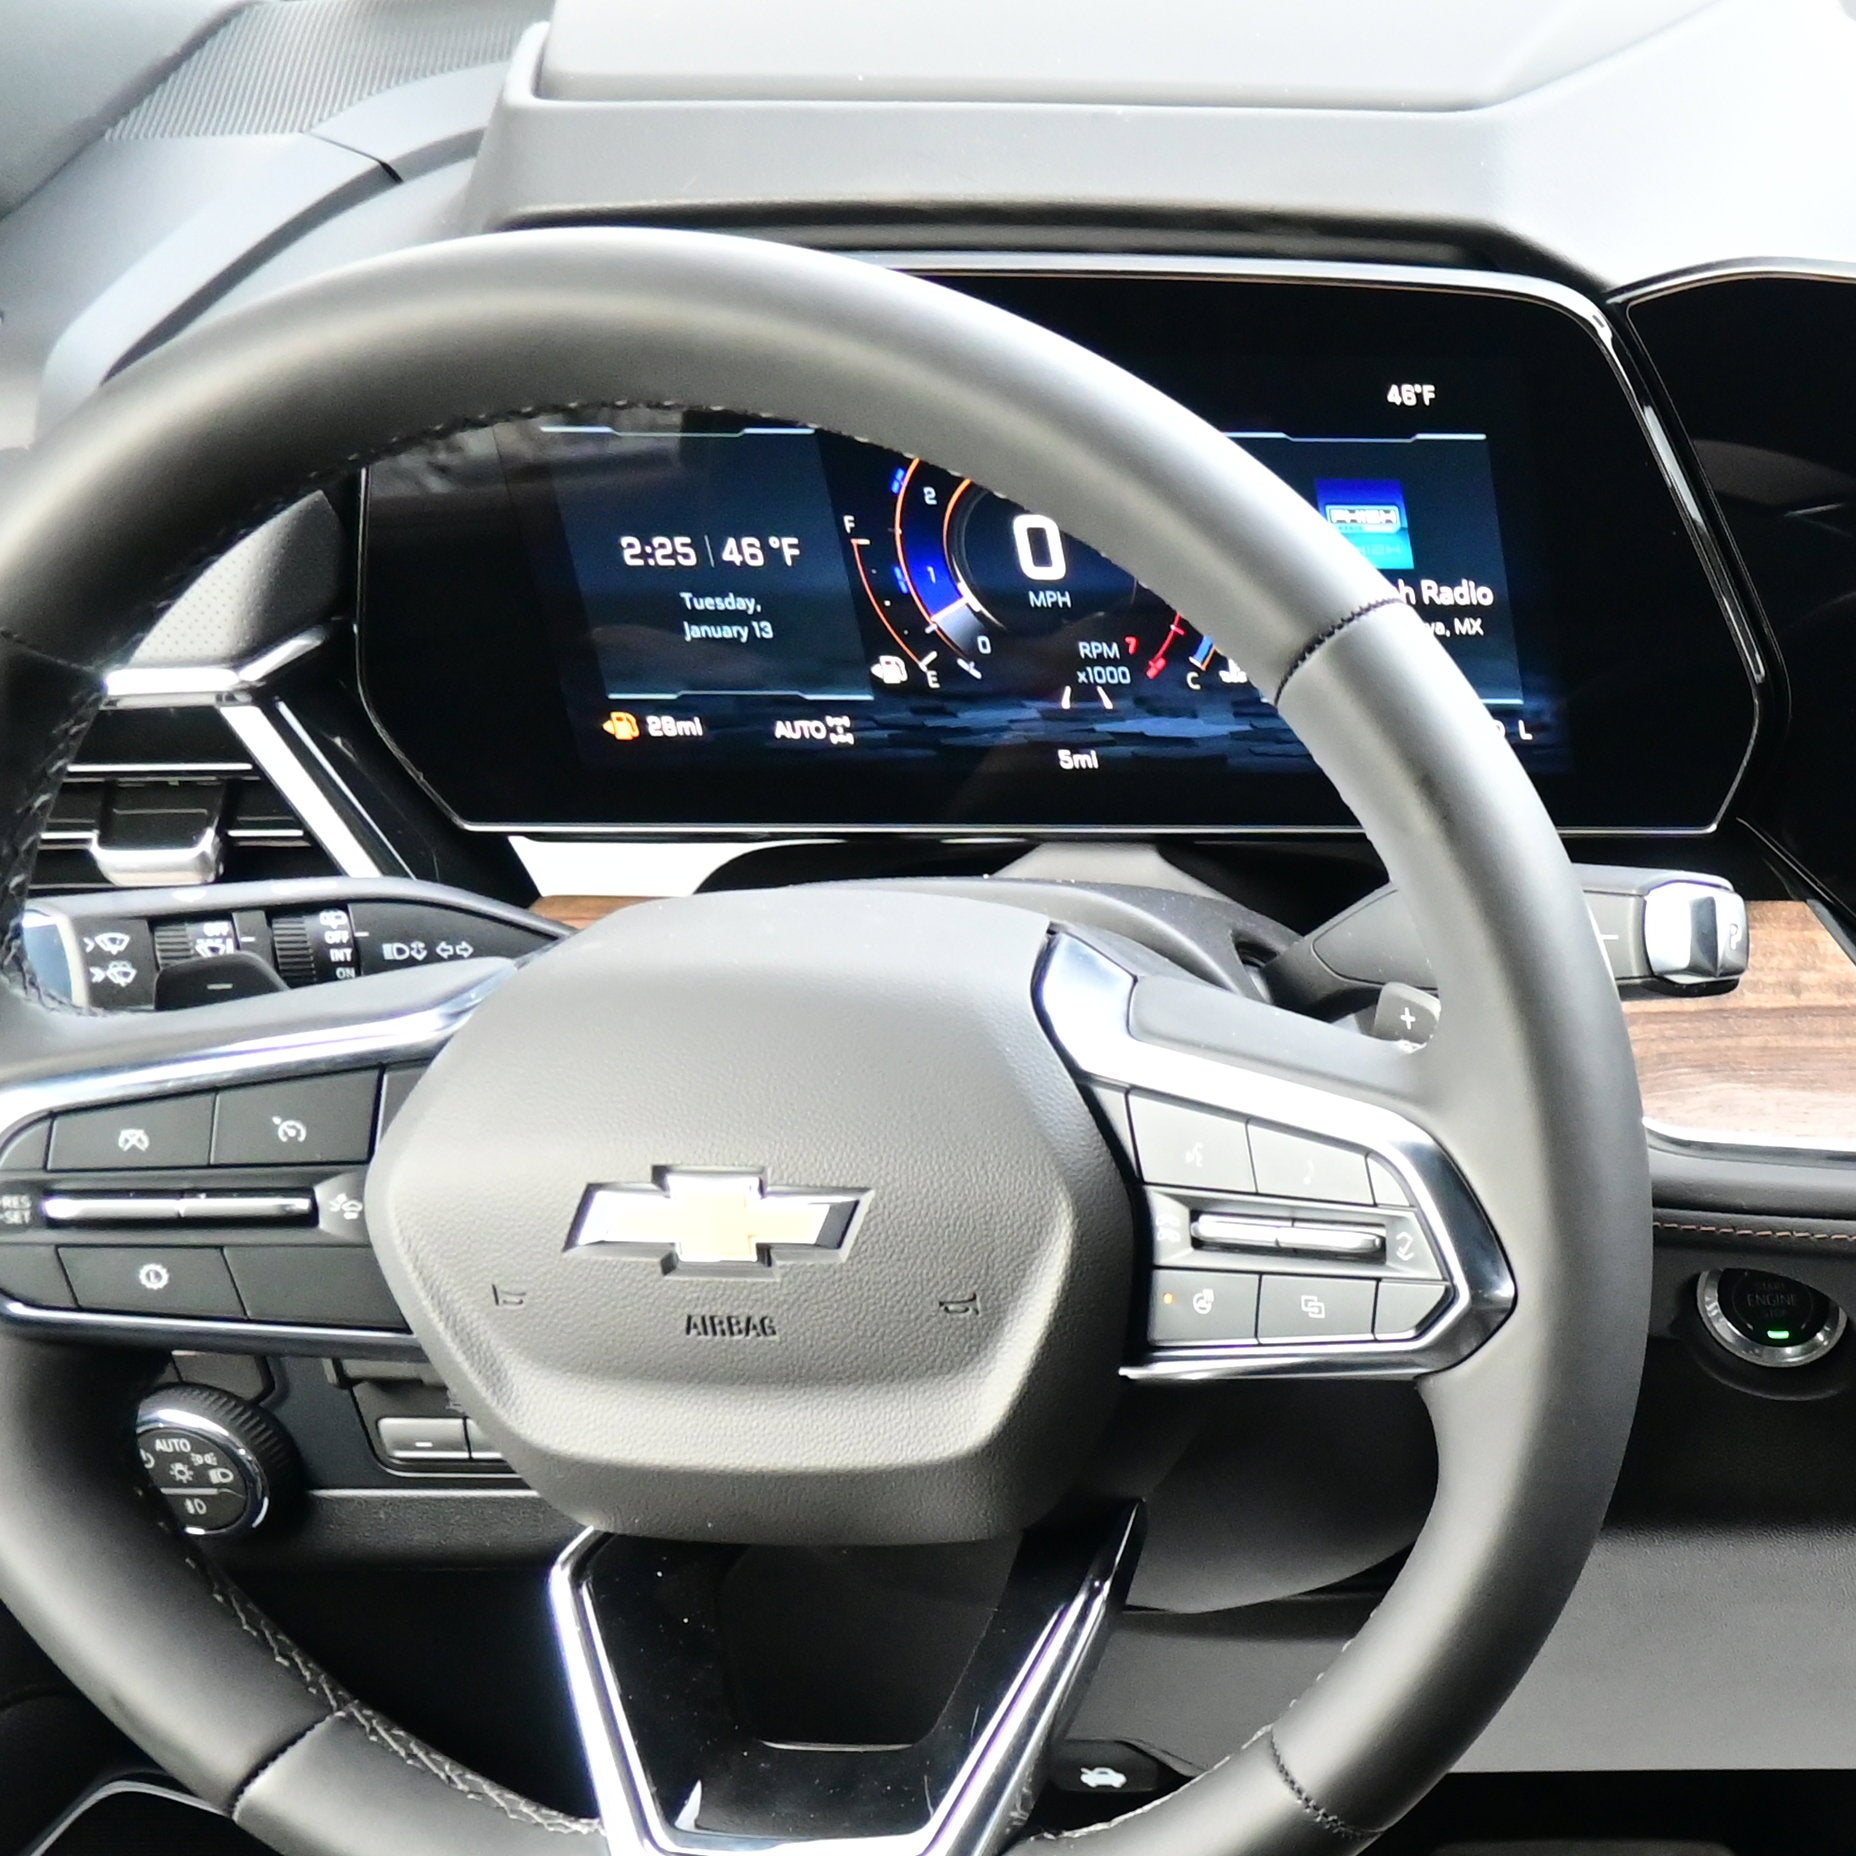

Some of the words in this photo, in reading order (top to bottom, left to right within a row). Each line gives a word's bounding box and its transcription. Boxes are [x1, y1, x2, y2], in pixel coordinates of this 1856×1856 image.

[1387, 384, 1435, 406] 46°F
[923, 487, 937, 505] 2
[843, 515, 855, 533] F
[620, 536, 697, 567] 2:25
[721, 536, 765, 567] 46
[1013, 514, 1067, 580] 0
[927, 566, 936, 583] 1
[1028, 590, 1072, 608] MPH
[1420, 578, 1494, 606] Radio
[680, 592, 762, 614] Tuesday,
[683, 621, 749, 642] January
[752, 621, 773, 639] 13
[1454, 617, 1484, 636] MX
[976, 636, 992, 654] 0
[1079, 641, 1120, 660] RPM
[927, 670, 940, 689] E
[1077, 665, 1131, 685] x1000
[1186, 672, 1201, 690] C
[775, 720, 827, 740] AUTO
[1058, 749, 1099, 770] 5mi
[686, 1314, 777, 1337] AIRBAG
[155, 1438, 192, 1453] AUTO
